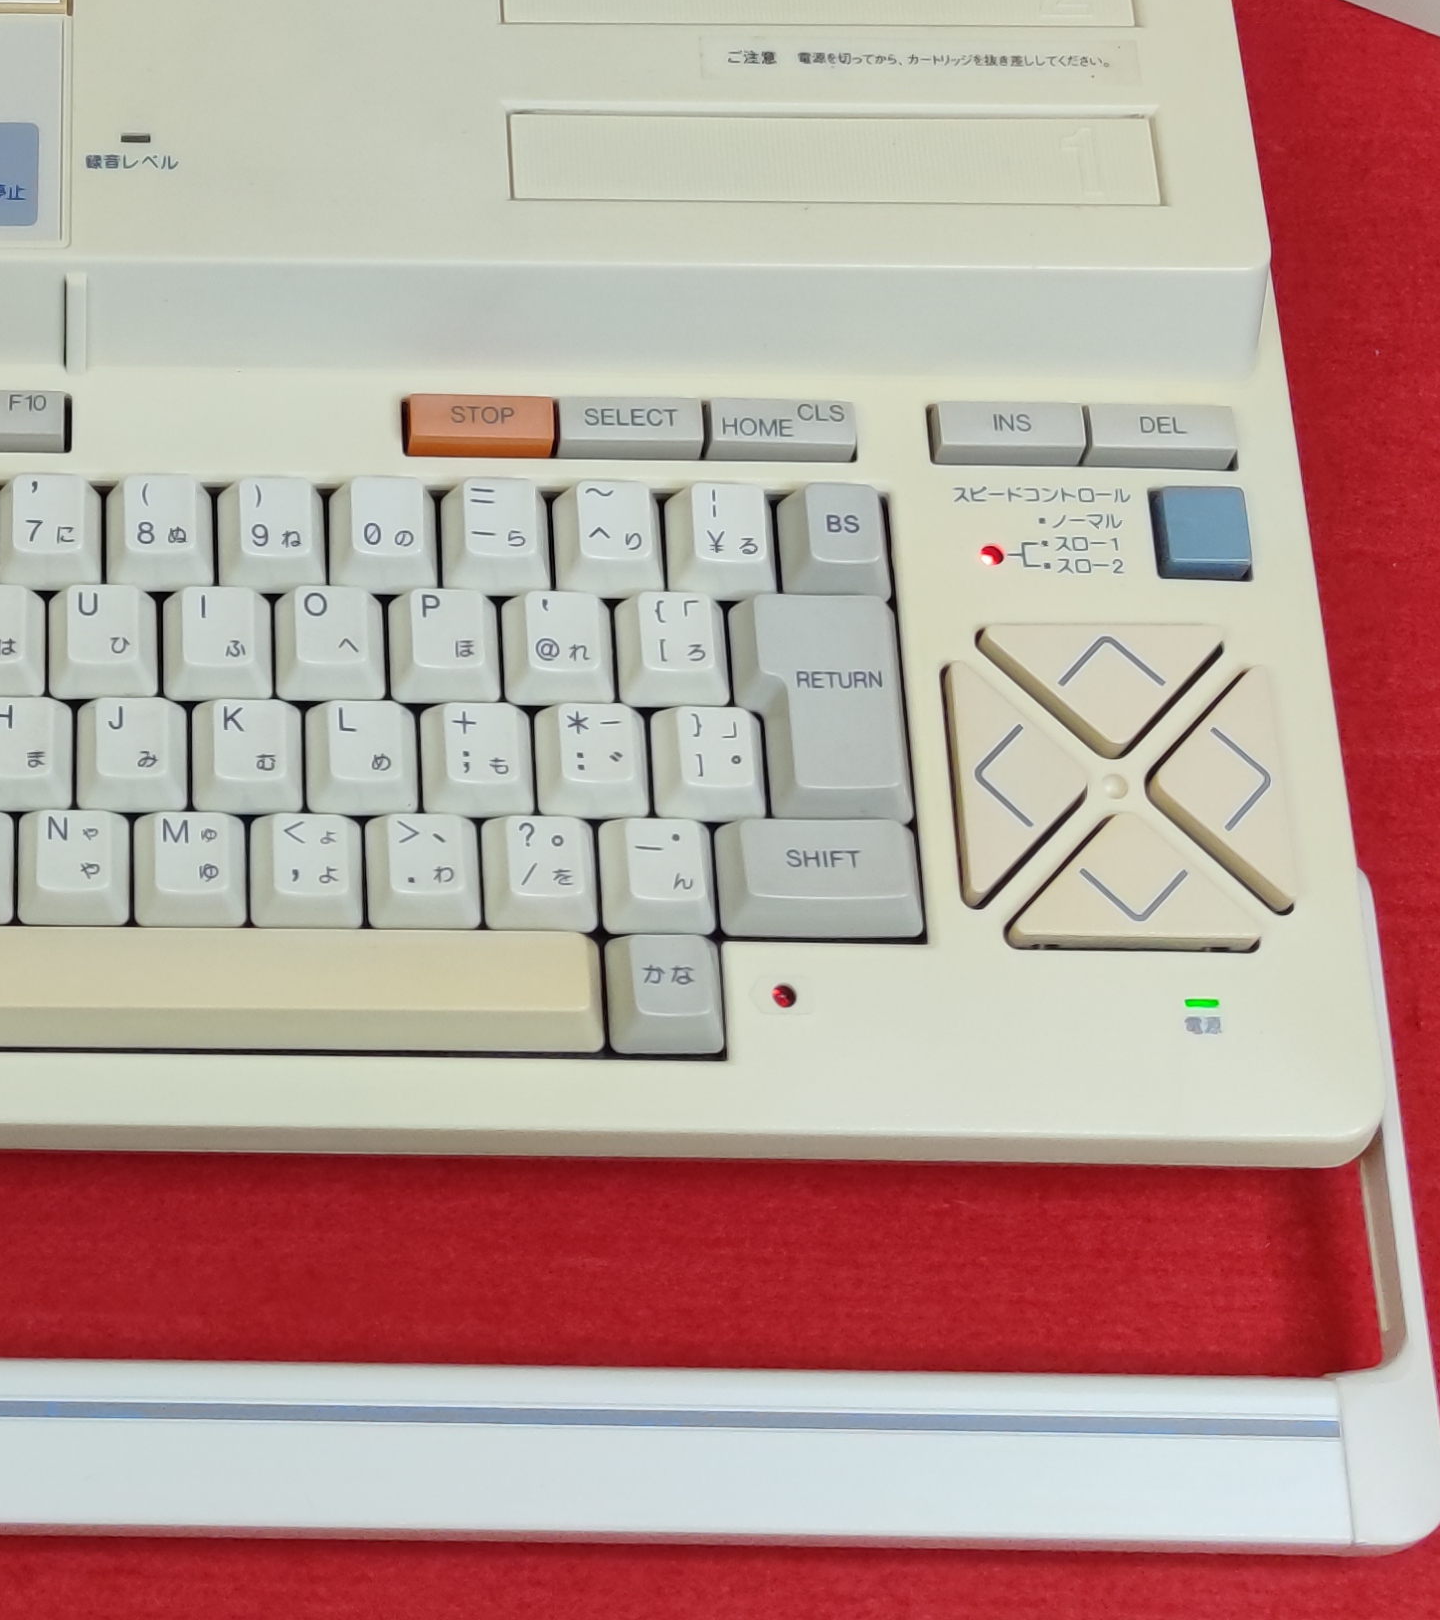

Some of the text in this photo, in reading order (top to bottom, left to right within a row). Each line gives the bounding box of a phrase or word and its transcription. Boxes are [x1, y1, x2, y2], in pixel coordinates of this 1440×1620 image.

[85, 154, 180, 171] 録音レベル
[9, 393, 48, 412] F10
[451, 406, 514, 424] STOP
[585, 408, 678, 426] SELECT
[797, 404, 844, 422] CLS
[722, 417, 794, 437] HOME
[993, 413, 1031, 433] INS
[1140, 416, 1187, 435] DEL
[953, 486, 1131, 504] スピードコントロール
[826, 514, 860, 533] BS
[1052, 514, 1123, 530] ノーマル
[25, 520, 75, 544] 7 に
[137, 522, 188, 544] 8 ぬ
[251, 524, 302, 548] 9 ね
[364, 523, 414, 547] 0 の
[508, 530, 526, 547] ら
[625, 533, 642, 550] り
[739, 538, 758, 555] る
[1055, 537, 1119, 552] スロー1
[1057, 559, 1124, 574] スロー2
[78, 592, 98, 616] U
[422, 594, 440, 618] P
[796, 671, 882, 689] RETURN
[108, 706, 123, 730] J
[223, 706, 244, 732] K
[339, 707, 357, 732] L
[48, 816, 68, 841] N
[163, 818, 189, 843] M
[786, 849, 860, 868] SHIFT
[642, 965, 694, 985] かな
